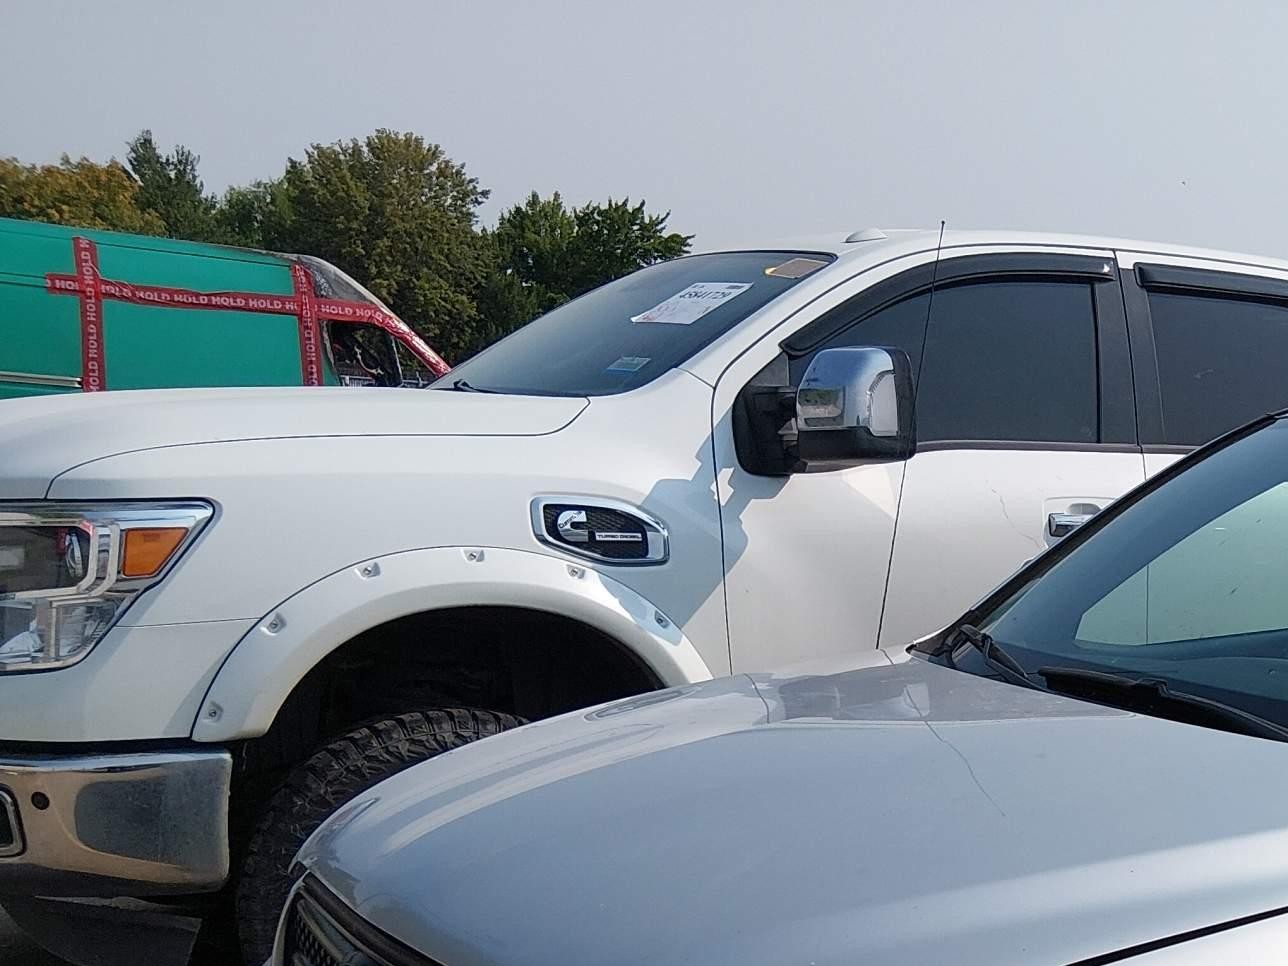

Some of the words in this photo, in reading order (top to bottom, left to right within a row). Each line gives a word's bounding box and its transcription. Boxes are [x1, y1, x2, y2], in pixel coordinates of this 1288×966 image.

[81, 251, 94, 284] HOLD
[86, 288, 97, 321] HOLD
[135, 290, 171, 303] HOLD
[174, 294, 208, 305] HOLD
[212, 296, 246, 308] HOLD
[249, 297, 282, 310] HOLD
[321, 303, 353, 315] HOLD
[87, 324, 98, 358] HOLD
[304, 329, 316, 361] HOLD
